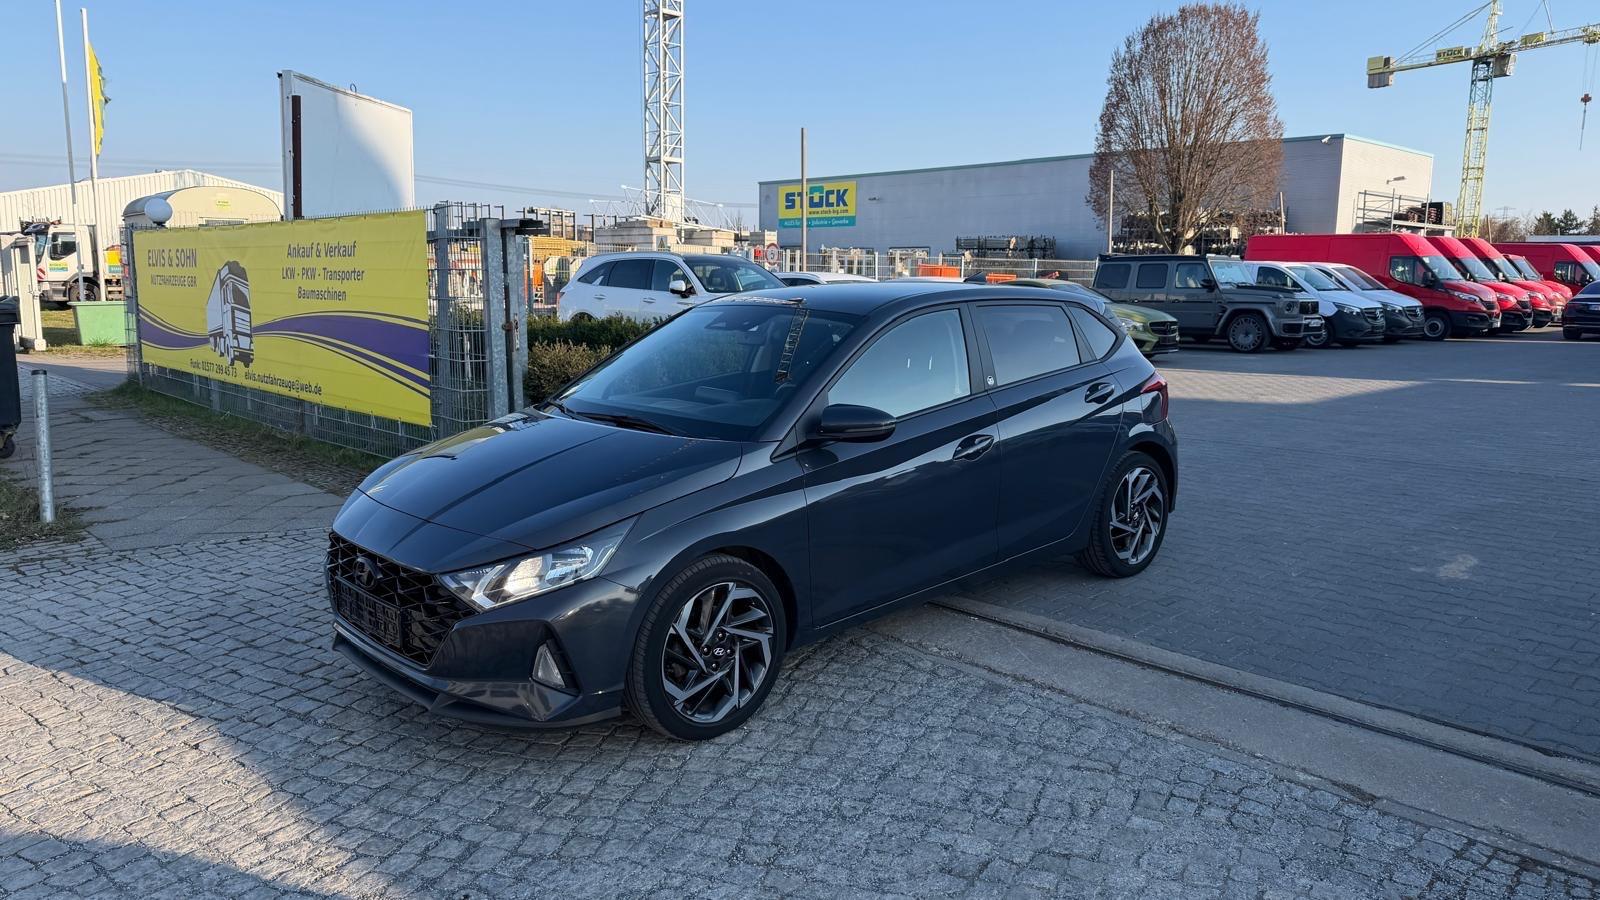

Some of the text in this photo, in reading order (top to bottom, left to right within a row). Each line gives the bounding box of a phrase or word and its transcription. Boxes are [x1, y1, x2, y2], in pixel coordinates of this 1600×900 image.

[148, 248, 197, 268] ELVIS & SOHN
[287, 240, 357, 258] Ankauf & Verkauf
[281, 267, 365, 284] LKW PKW Transporter
[297, 286, 347, 301] Baumaschinen
[201, 360, 214, 372] 01577
[244, 370, 322, 396] elvis.nutzfahrzeuge@web.de
